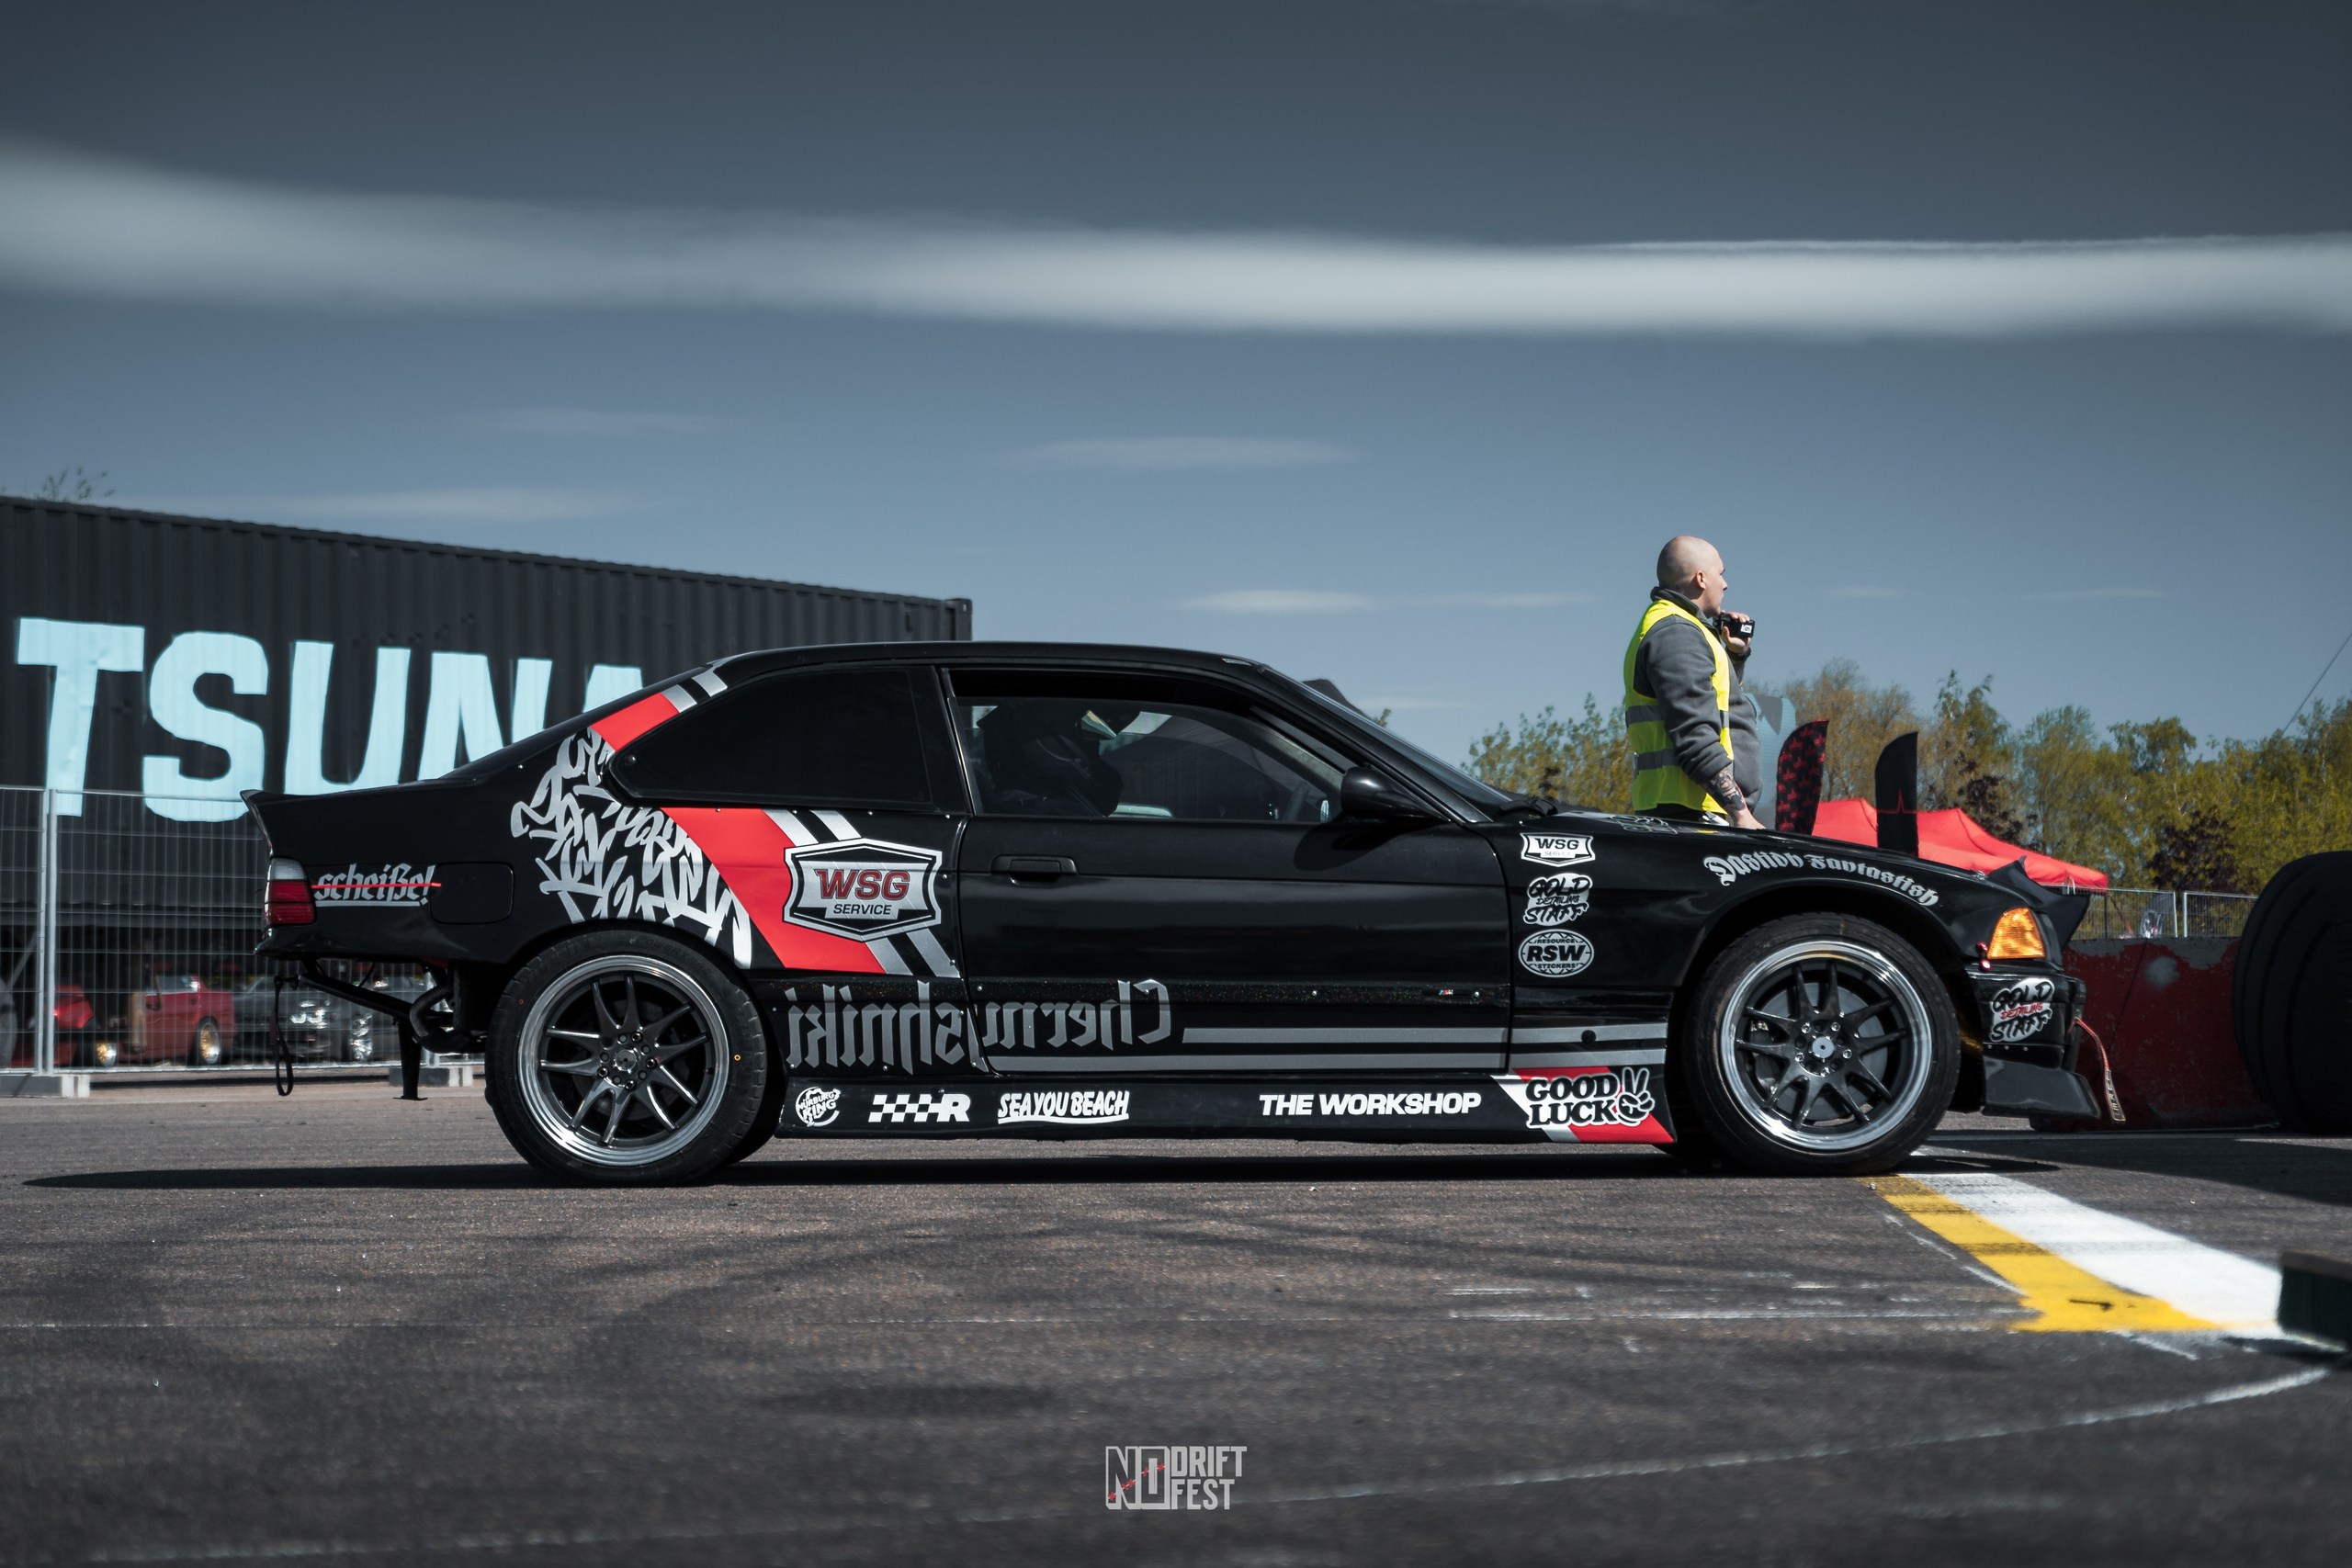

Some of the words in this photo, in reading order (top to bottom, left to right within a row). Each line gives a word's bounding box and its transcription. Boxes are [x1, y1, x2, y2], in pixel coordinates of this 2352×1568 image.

[16, 617, 643, 822] TSUN
[1535, 838, 1579, 850] WSG
[815, 868, 910, 900] WSG
[1528, 876, 1590, 897] GOLD
[833, 903, 892, 915] SERVICE
[1535, 895, 1580, 905] DETAILING
[1524, 902, 1589, 923] STAFF
[1526, 944, 1587, 963] RSW
[1993, 980, 2052, 1012] GOLD
[2000, 1002, 2043, 1020] DETAILING
[1990, 1009, 2053, 1041] STAFF
[1525, 1074, 1619, 1101] GOOD
[802, 1099, 837, 1121] KING
[1070, 1090, 1130, 1117] BEACH
[1259, 1094, 1314, 1116] THE
[1318, 1092, 1482, 1115] WORKSHOP
[1529, 1099, 1618, 1126] LUCK
